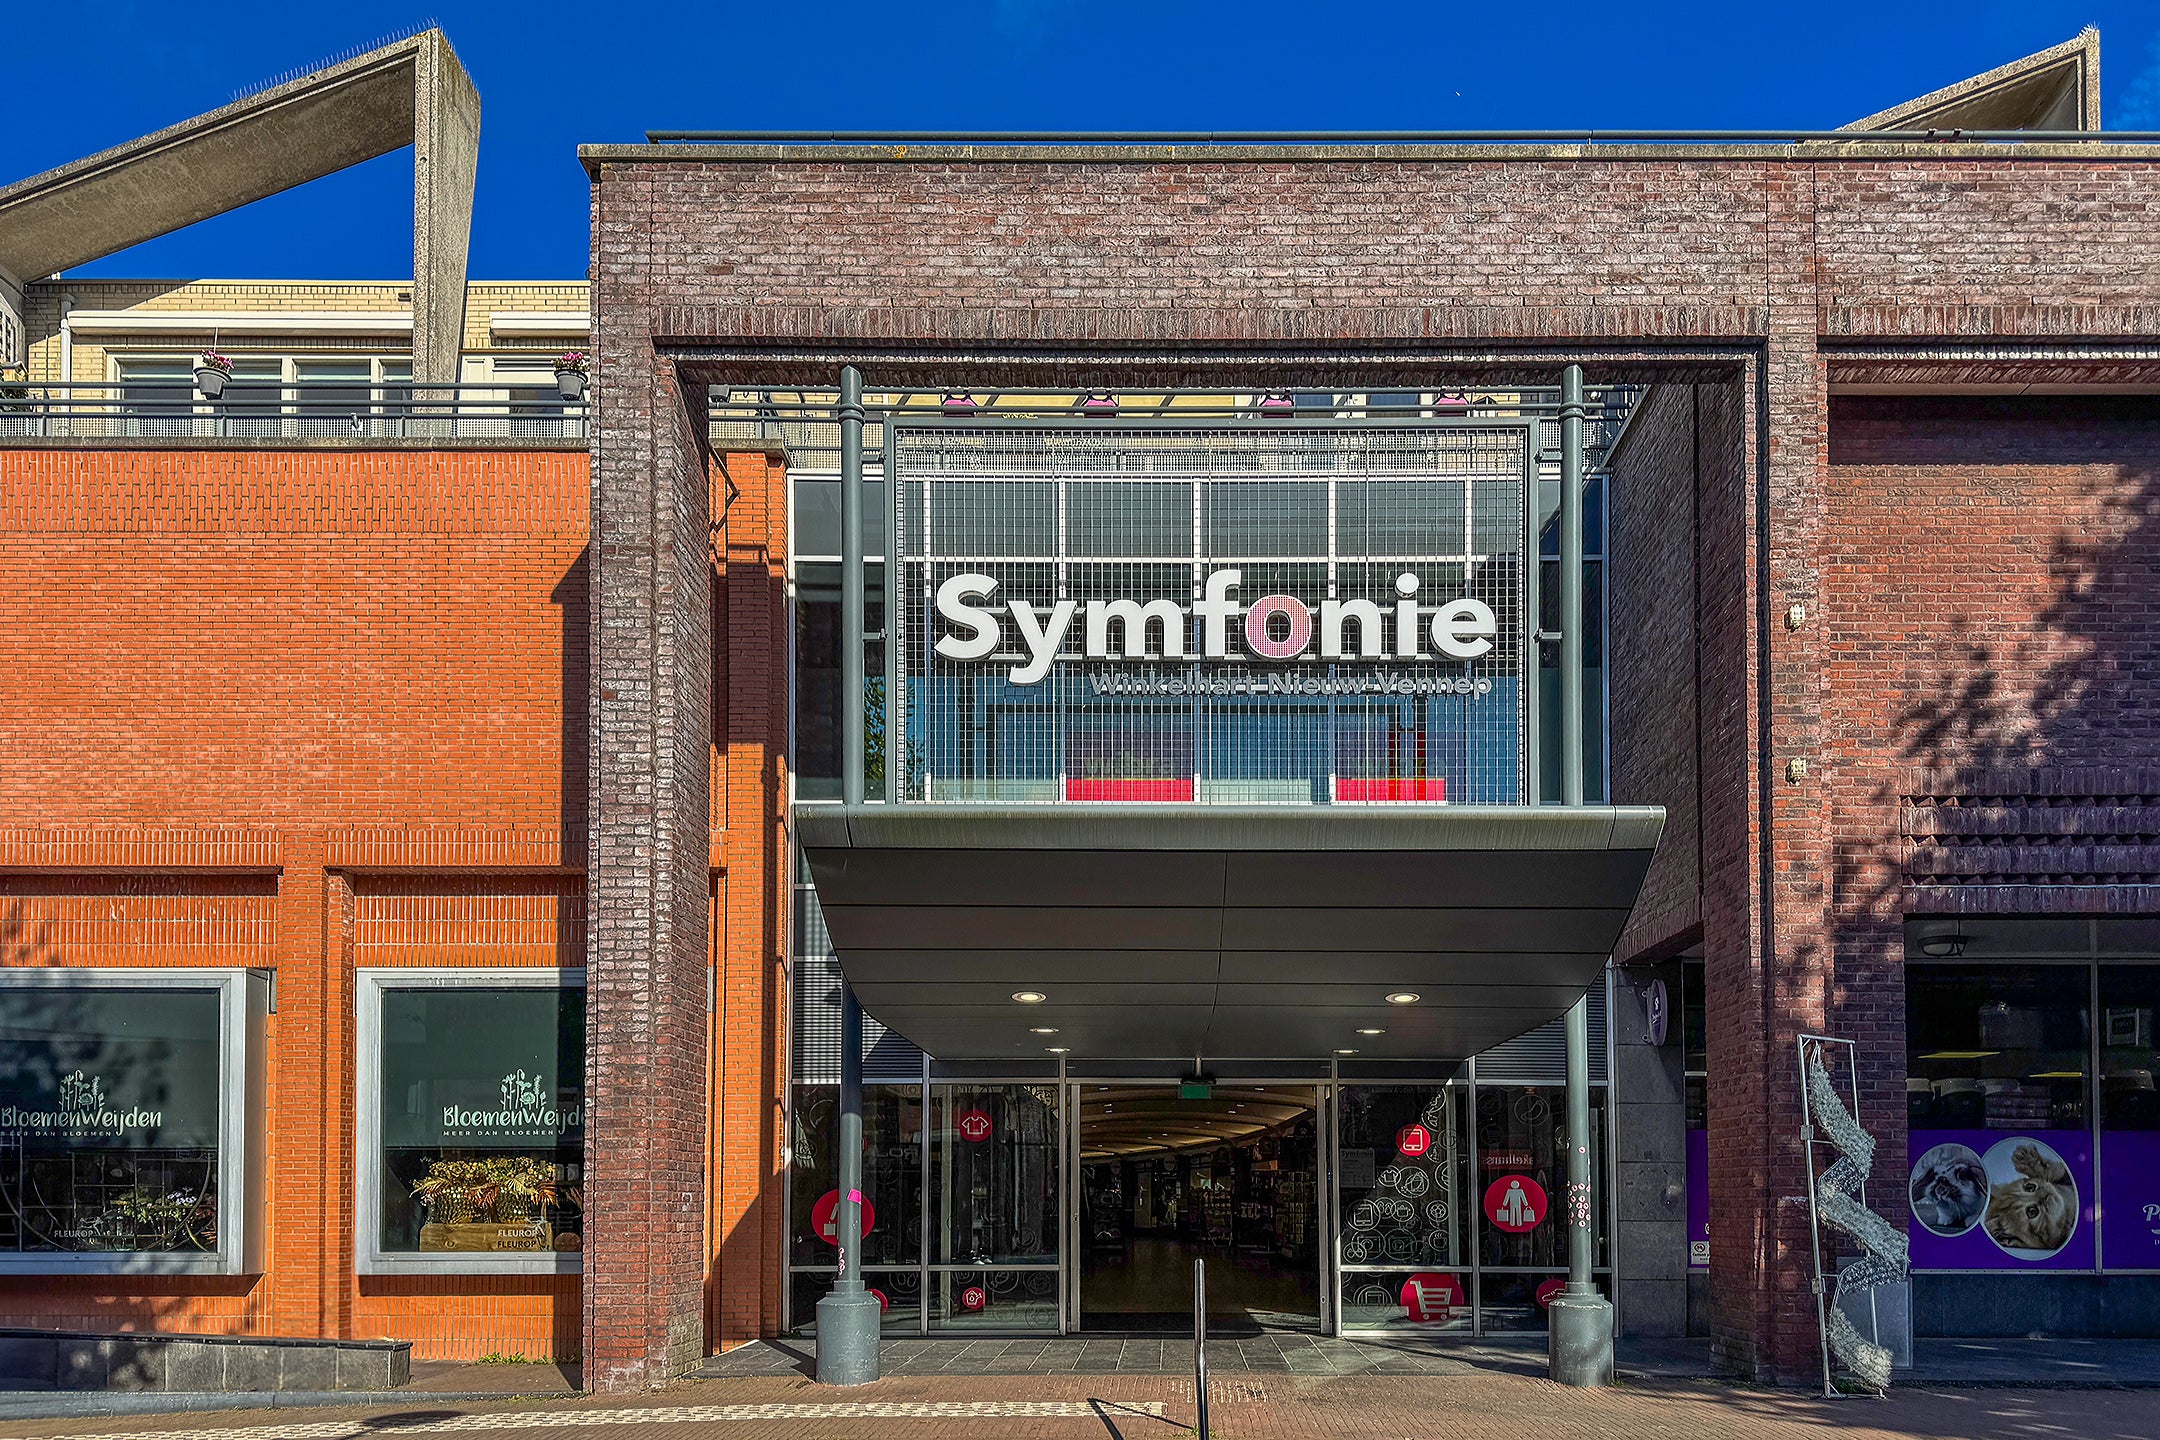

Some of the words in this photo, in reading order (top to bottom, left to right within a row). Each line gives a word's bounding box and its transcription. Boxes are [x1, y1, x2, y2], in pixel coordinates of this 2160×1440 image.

[934, 569, 1497, 686] Symfonie
[1089, 671, 1256, 695] Winkelhart
[54, 1229, 94, 1238] FLEUROP
[497, 1229, 538, 1238] FLEUROP
